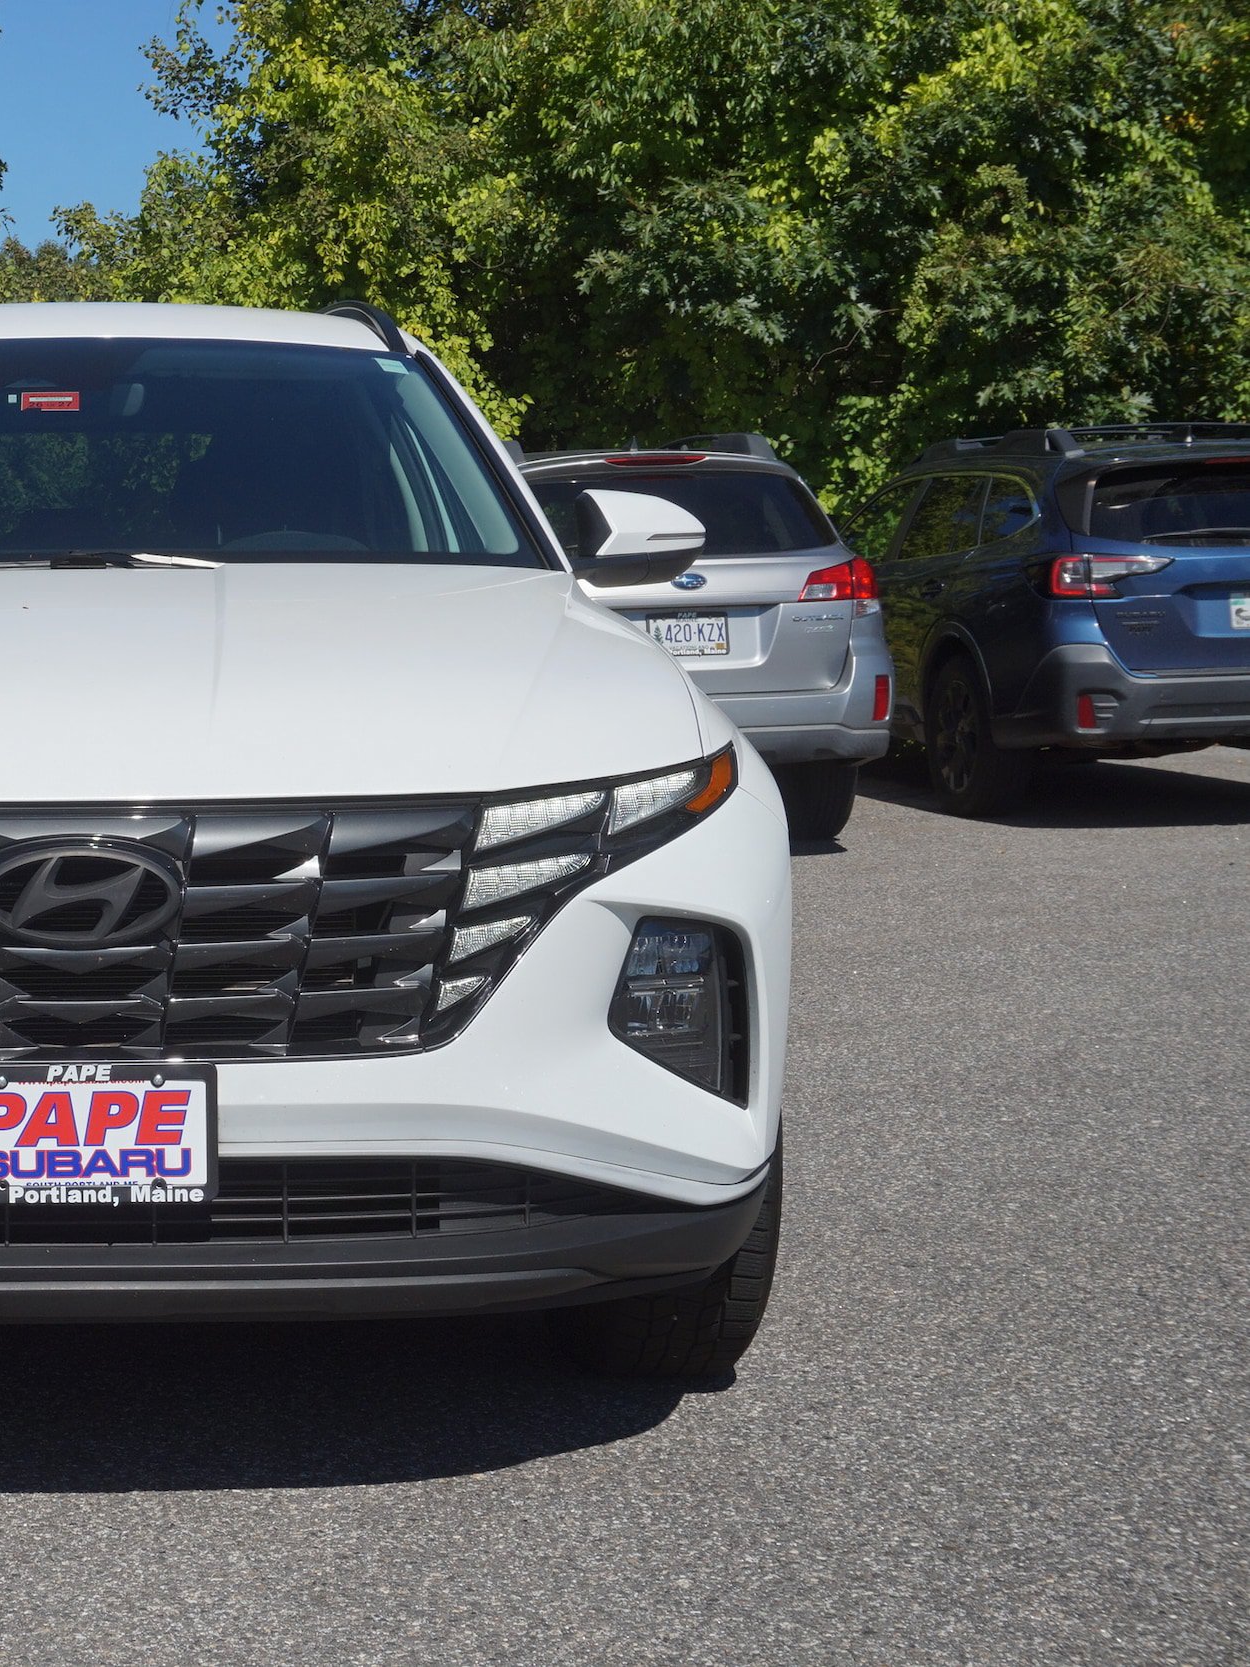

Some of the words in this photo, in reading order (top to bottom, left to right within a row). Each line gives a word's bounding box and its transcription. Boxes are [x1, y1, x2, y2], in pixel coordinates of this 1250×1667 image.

[47, 1064, 112, 1081] PAPE
[9, 1185, 119, 1207] Portland,
[131, 1185, 204, 1204] Maine
